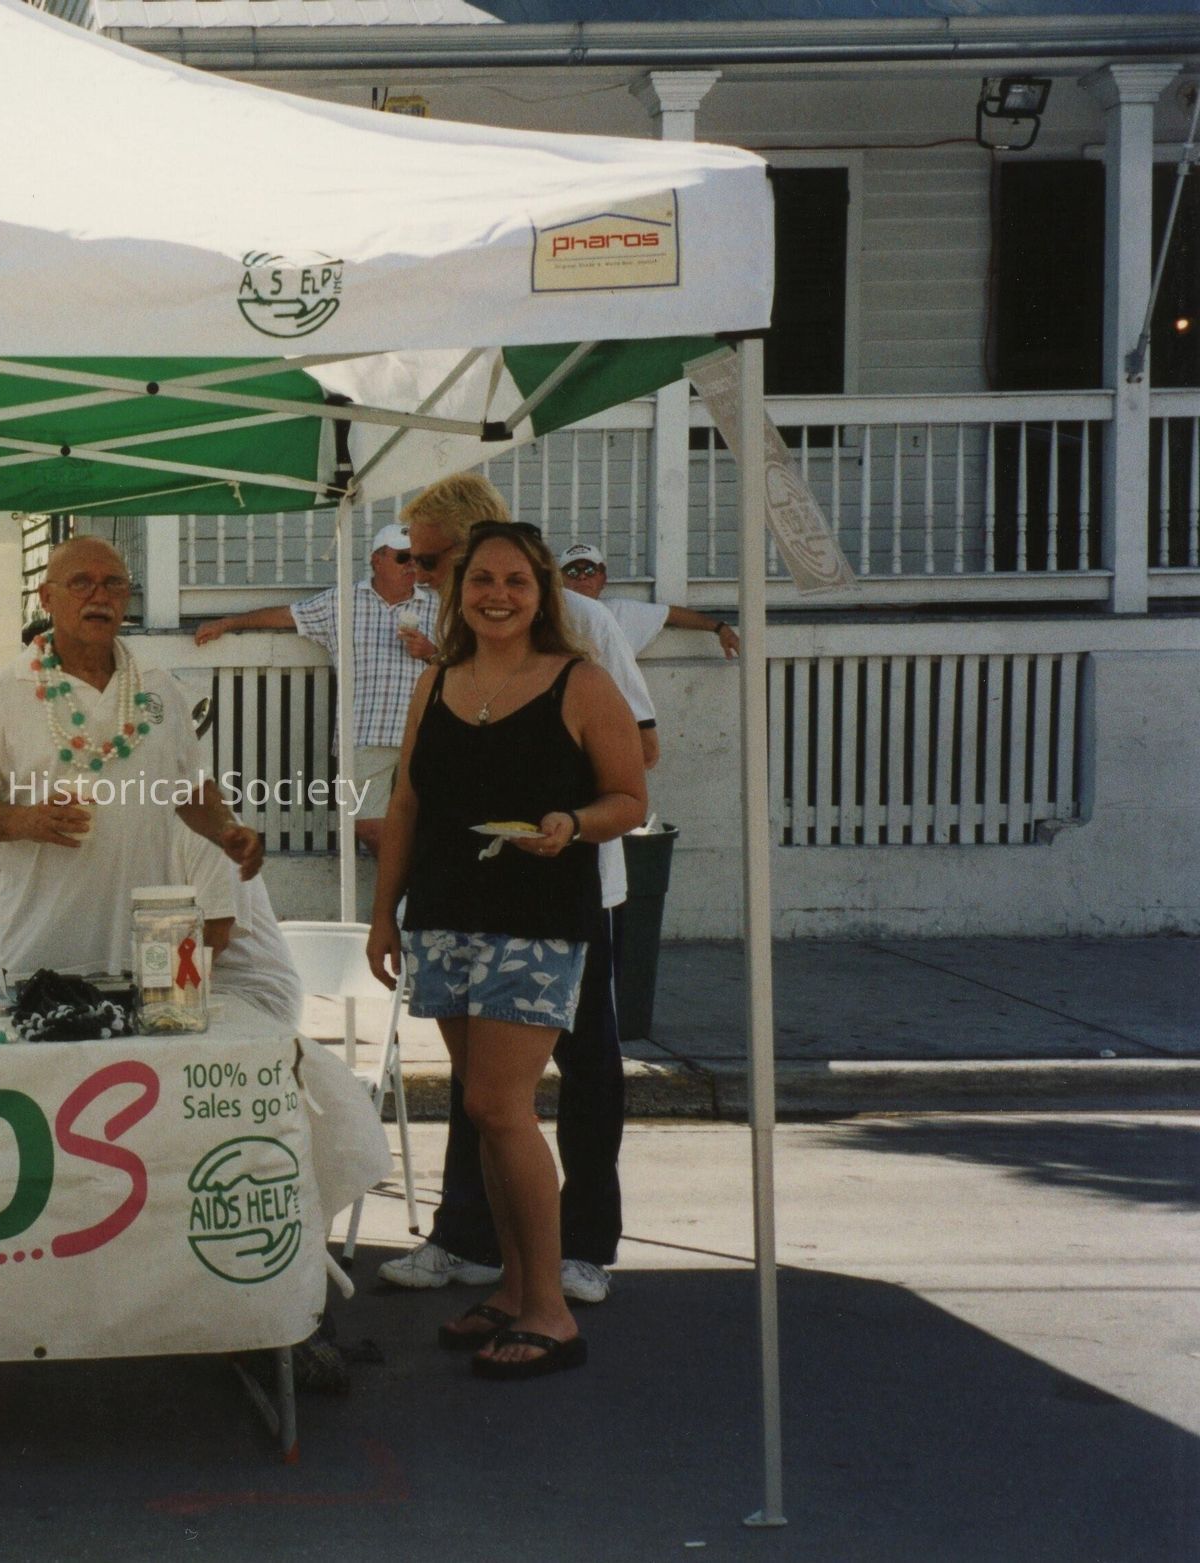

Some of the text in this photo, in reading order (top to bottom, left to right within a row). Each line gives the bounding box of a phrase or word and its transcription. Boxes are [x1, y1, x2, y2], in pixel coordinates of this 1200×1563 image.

[552, 232, 660, 257] pharos
[183, 1060, 282, 1088] 100% of
[183, 1094, 241, 1119] Sales
[252, 1098, 281, 1123] go
[190, 1197, 242, 1230] AIDS
[247, 1184, 293, 1223] HELP
